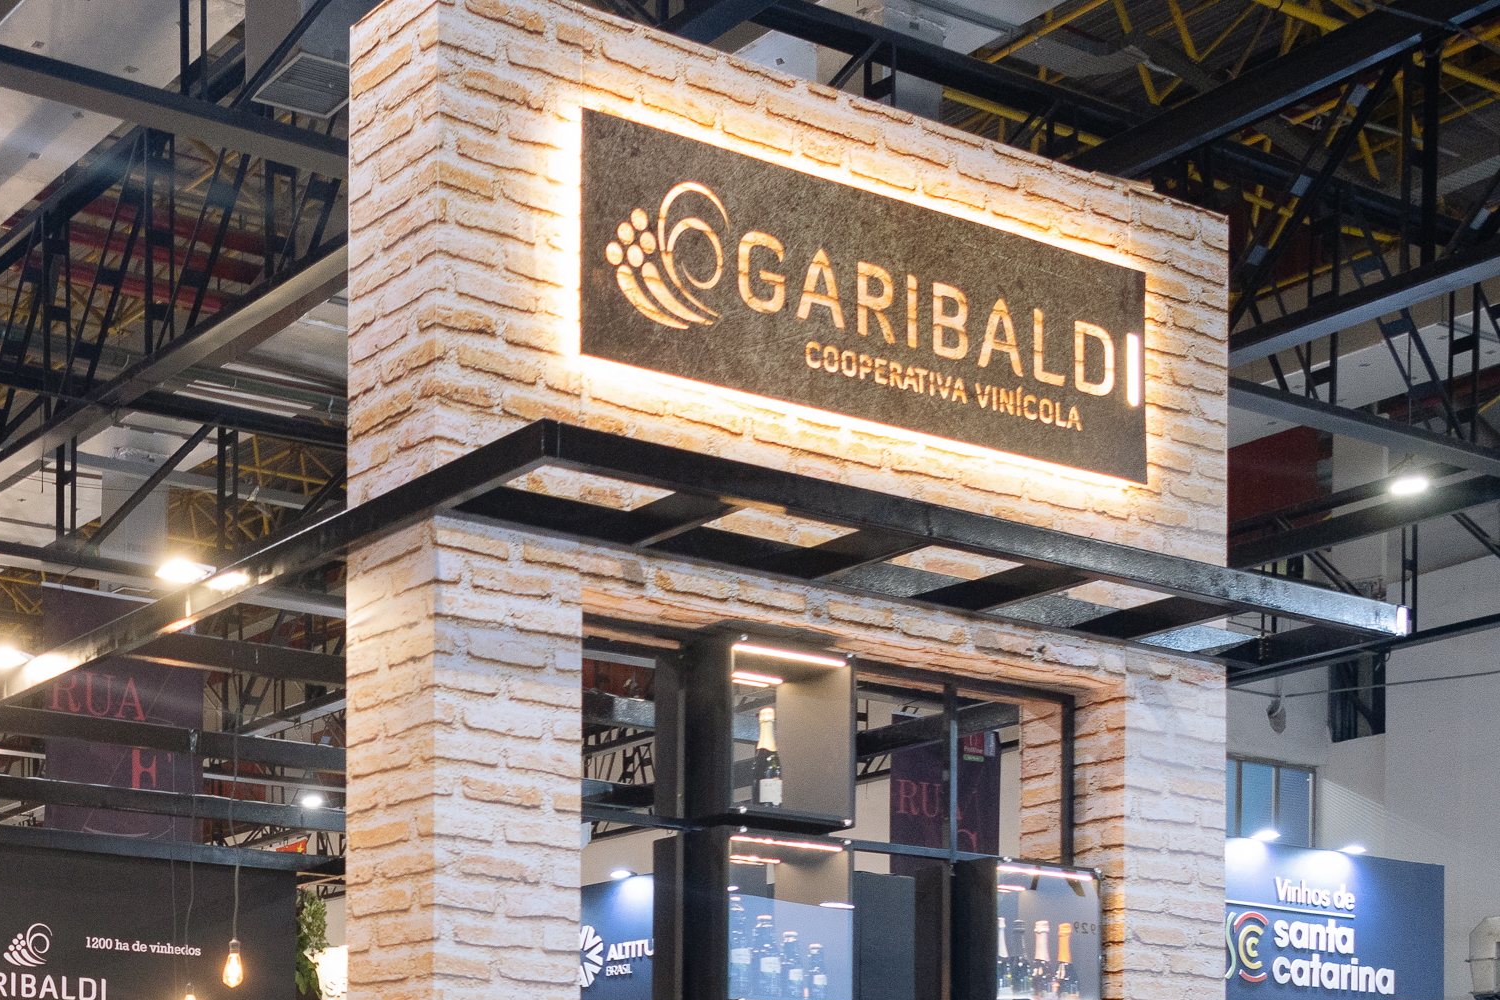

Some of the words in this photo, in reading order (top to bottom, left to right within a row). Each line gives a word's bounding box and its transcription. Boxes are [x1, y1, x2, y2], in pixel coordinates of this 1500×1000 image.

[737, 230, 1141, 407] GARIBALDI
[805, 341, 968, 405] COOPERATIVA
[975, 385, 1083, 432] VINÍCOLA
[50, 671, 146, 721] RUA
[896, 779, 962, 820] RU
[1274, 876, 1331, 908] Vinhos
[1332, 884, 1355, 910] de
[85, 936, 113, 950] 1200
[114, 938, 130, 951] ha
[131, 940, 147, 952] de
[149, 942, 201, 956] vinhedos
[1273, 918, 1355, 954] santa
[606, 963, 633, 977] BRASIL
[1272, 954, 1395, 995] catarina
